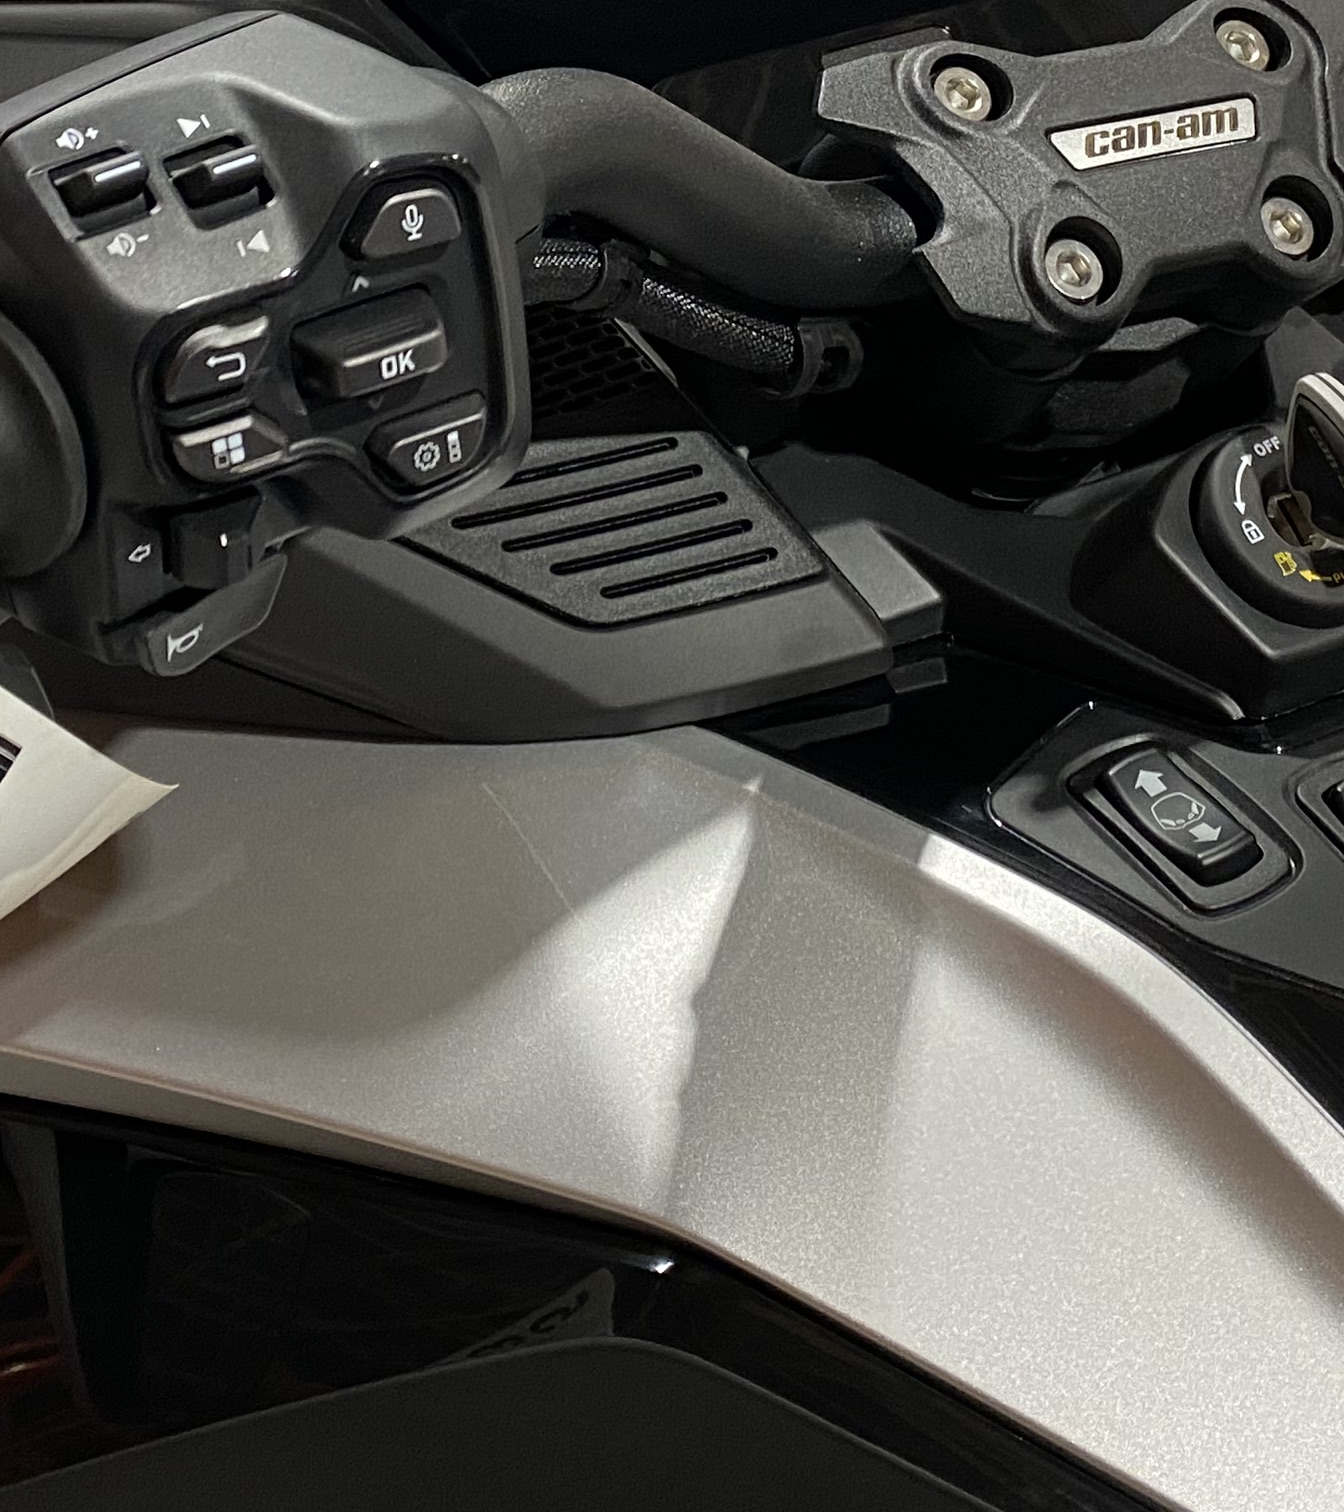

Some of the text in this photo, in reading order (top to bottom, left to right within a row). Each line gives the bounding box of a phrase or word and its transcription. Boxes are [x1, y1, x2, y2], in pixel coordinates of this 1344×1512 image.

[1084, 106, 1239, 159] can-am
[381, 349, 416, 380] OK
[1253, 435, 1281, 458] OFF
